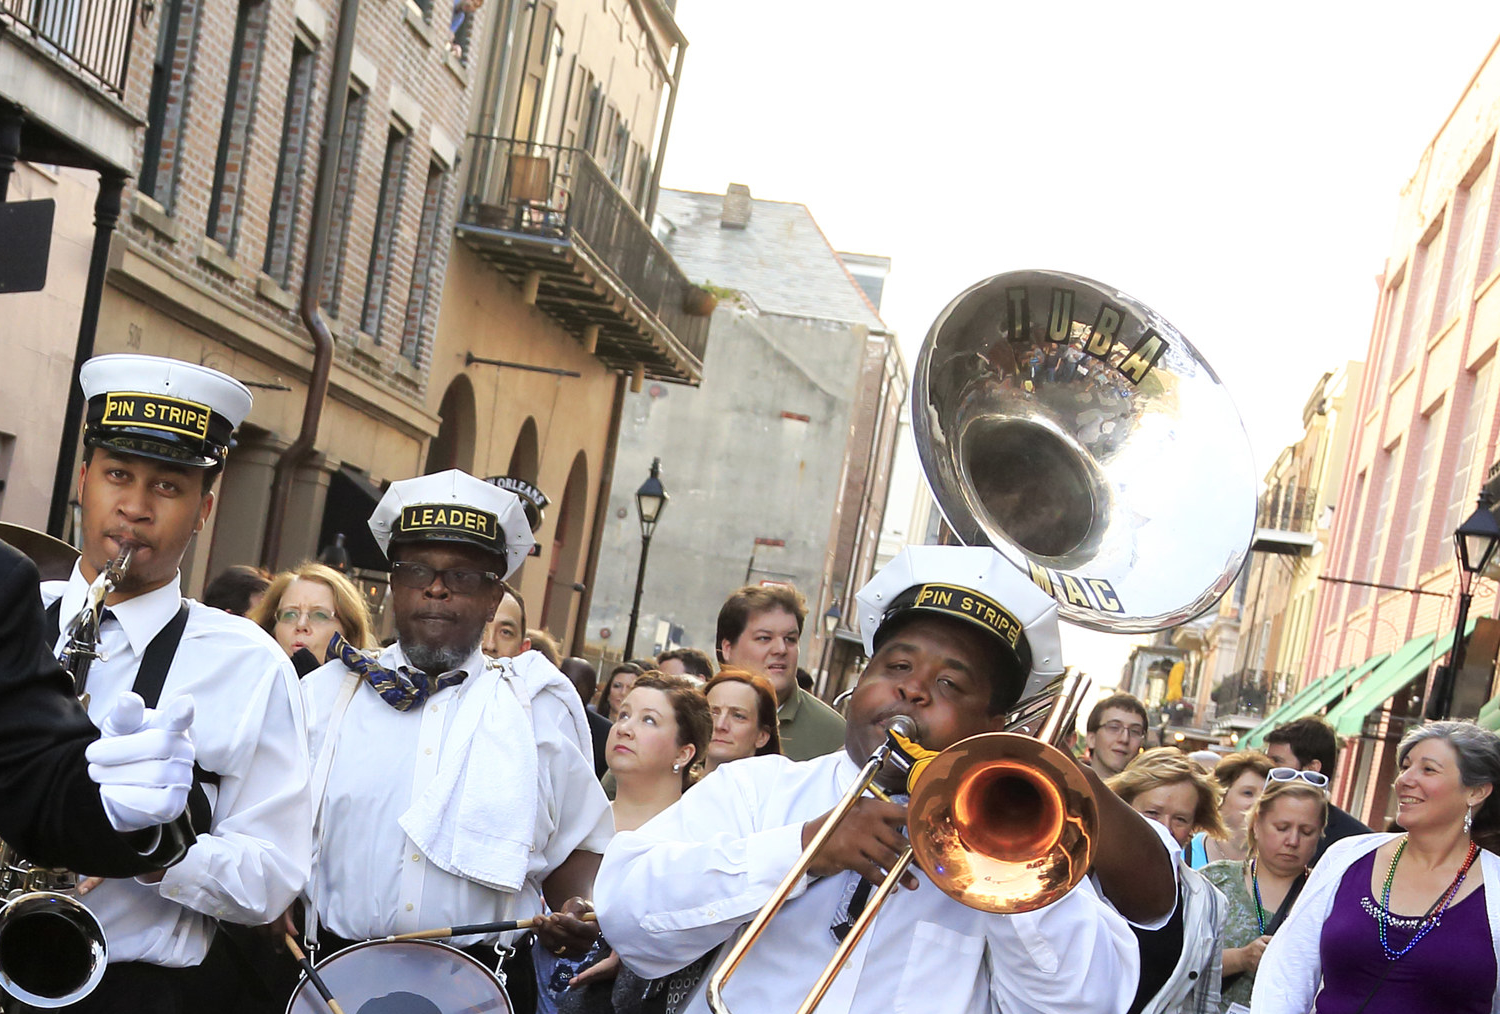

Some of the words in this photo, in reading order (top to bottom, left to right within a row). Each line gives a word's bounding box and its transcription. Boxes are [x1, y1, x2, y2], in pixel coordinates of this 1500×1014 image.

[1006, 287, 1164, 384] TUBA
[107, 400, 135, 417] PIN
[143, 402, 207, 430] STRIPE
[497, 477, 546, 506] ORLEANS
[410, 508, 488, 532] LEADER
[1028, 561, 1120, 613] MAC
[922, 588, 953, 607] PIN
[960, 594, 1021, 643] STRIPE
